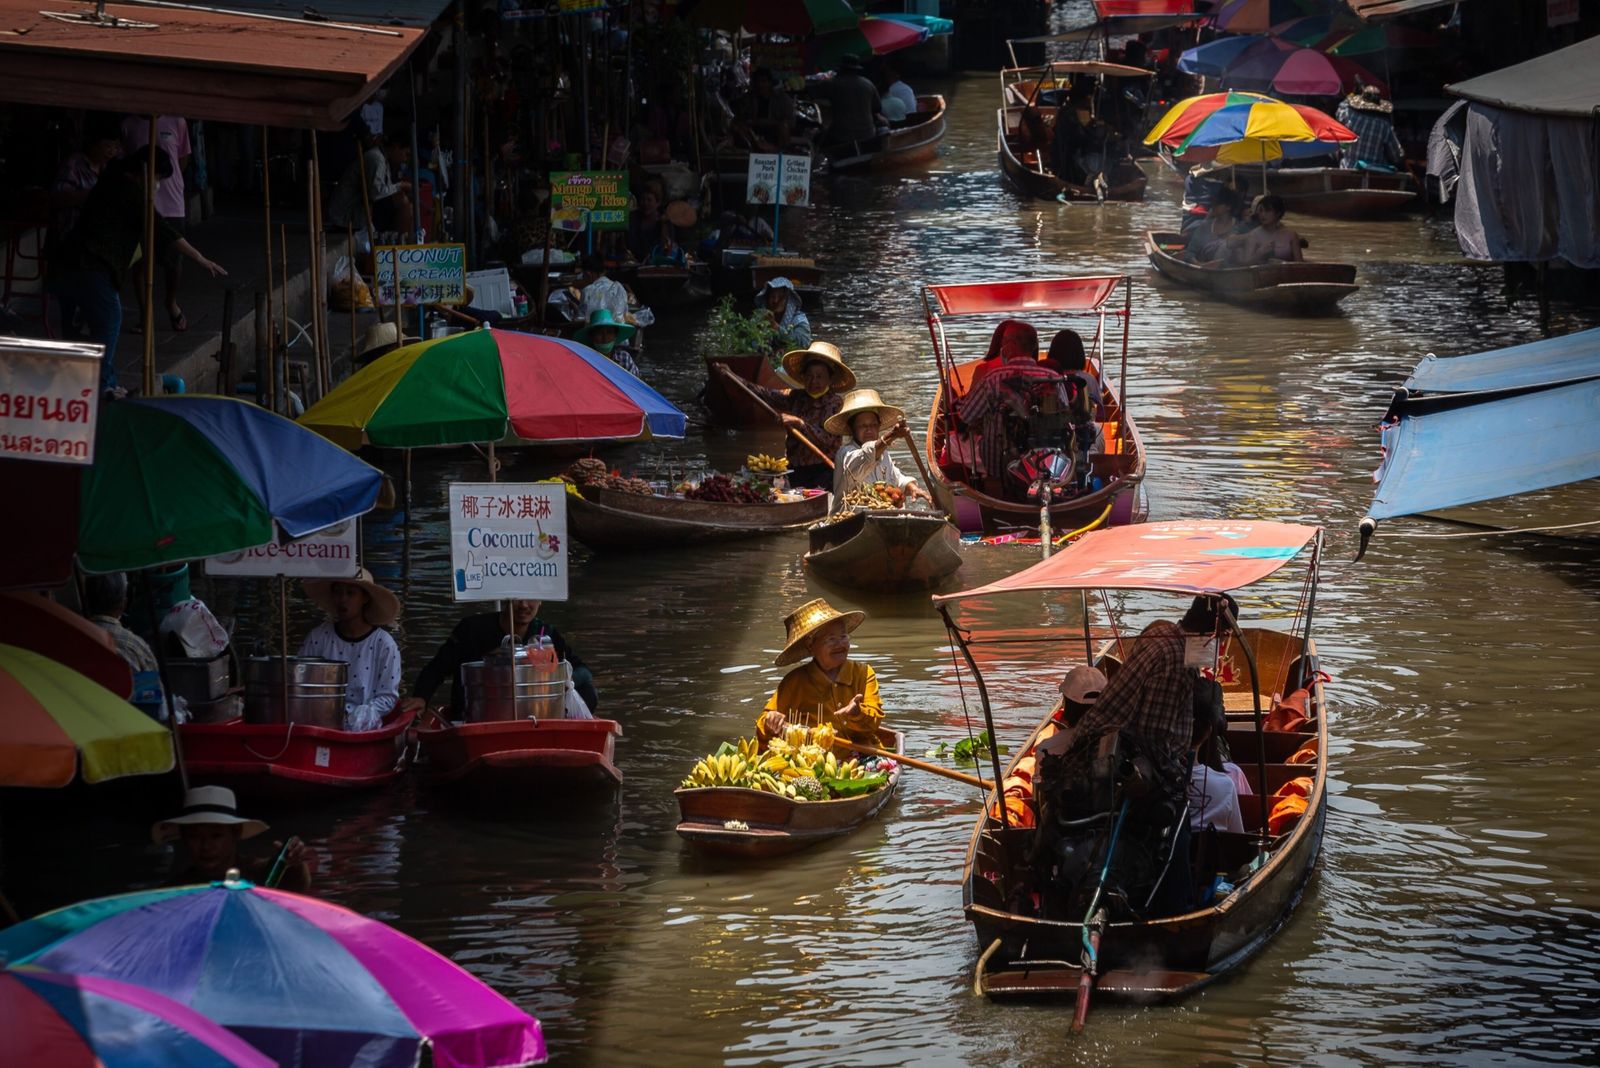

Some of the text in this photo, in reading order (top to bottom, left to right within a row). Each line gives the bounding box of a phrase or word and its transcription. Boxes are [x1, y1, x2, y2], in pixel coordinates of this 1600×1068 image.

[552, 182, 592, 195] Mango
[562, 195, 627, 209] Sticky Rice
[461, 495, 552, 519] 椰子冰淇淋
[467, 527, 535, 549] Coconut
[484, 556, 558, 577] ice-cream
[466, 573, 482, 582] LIKE
